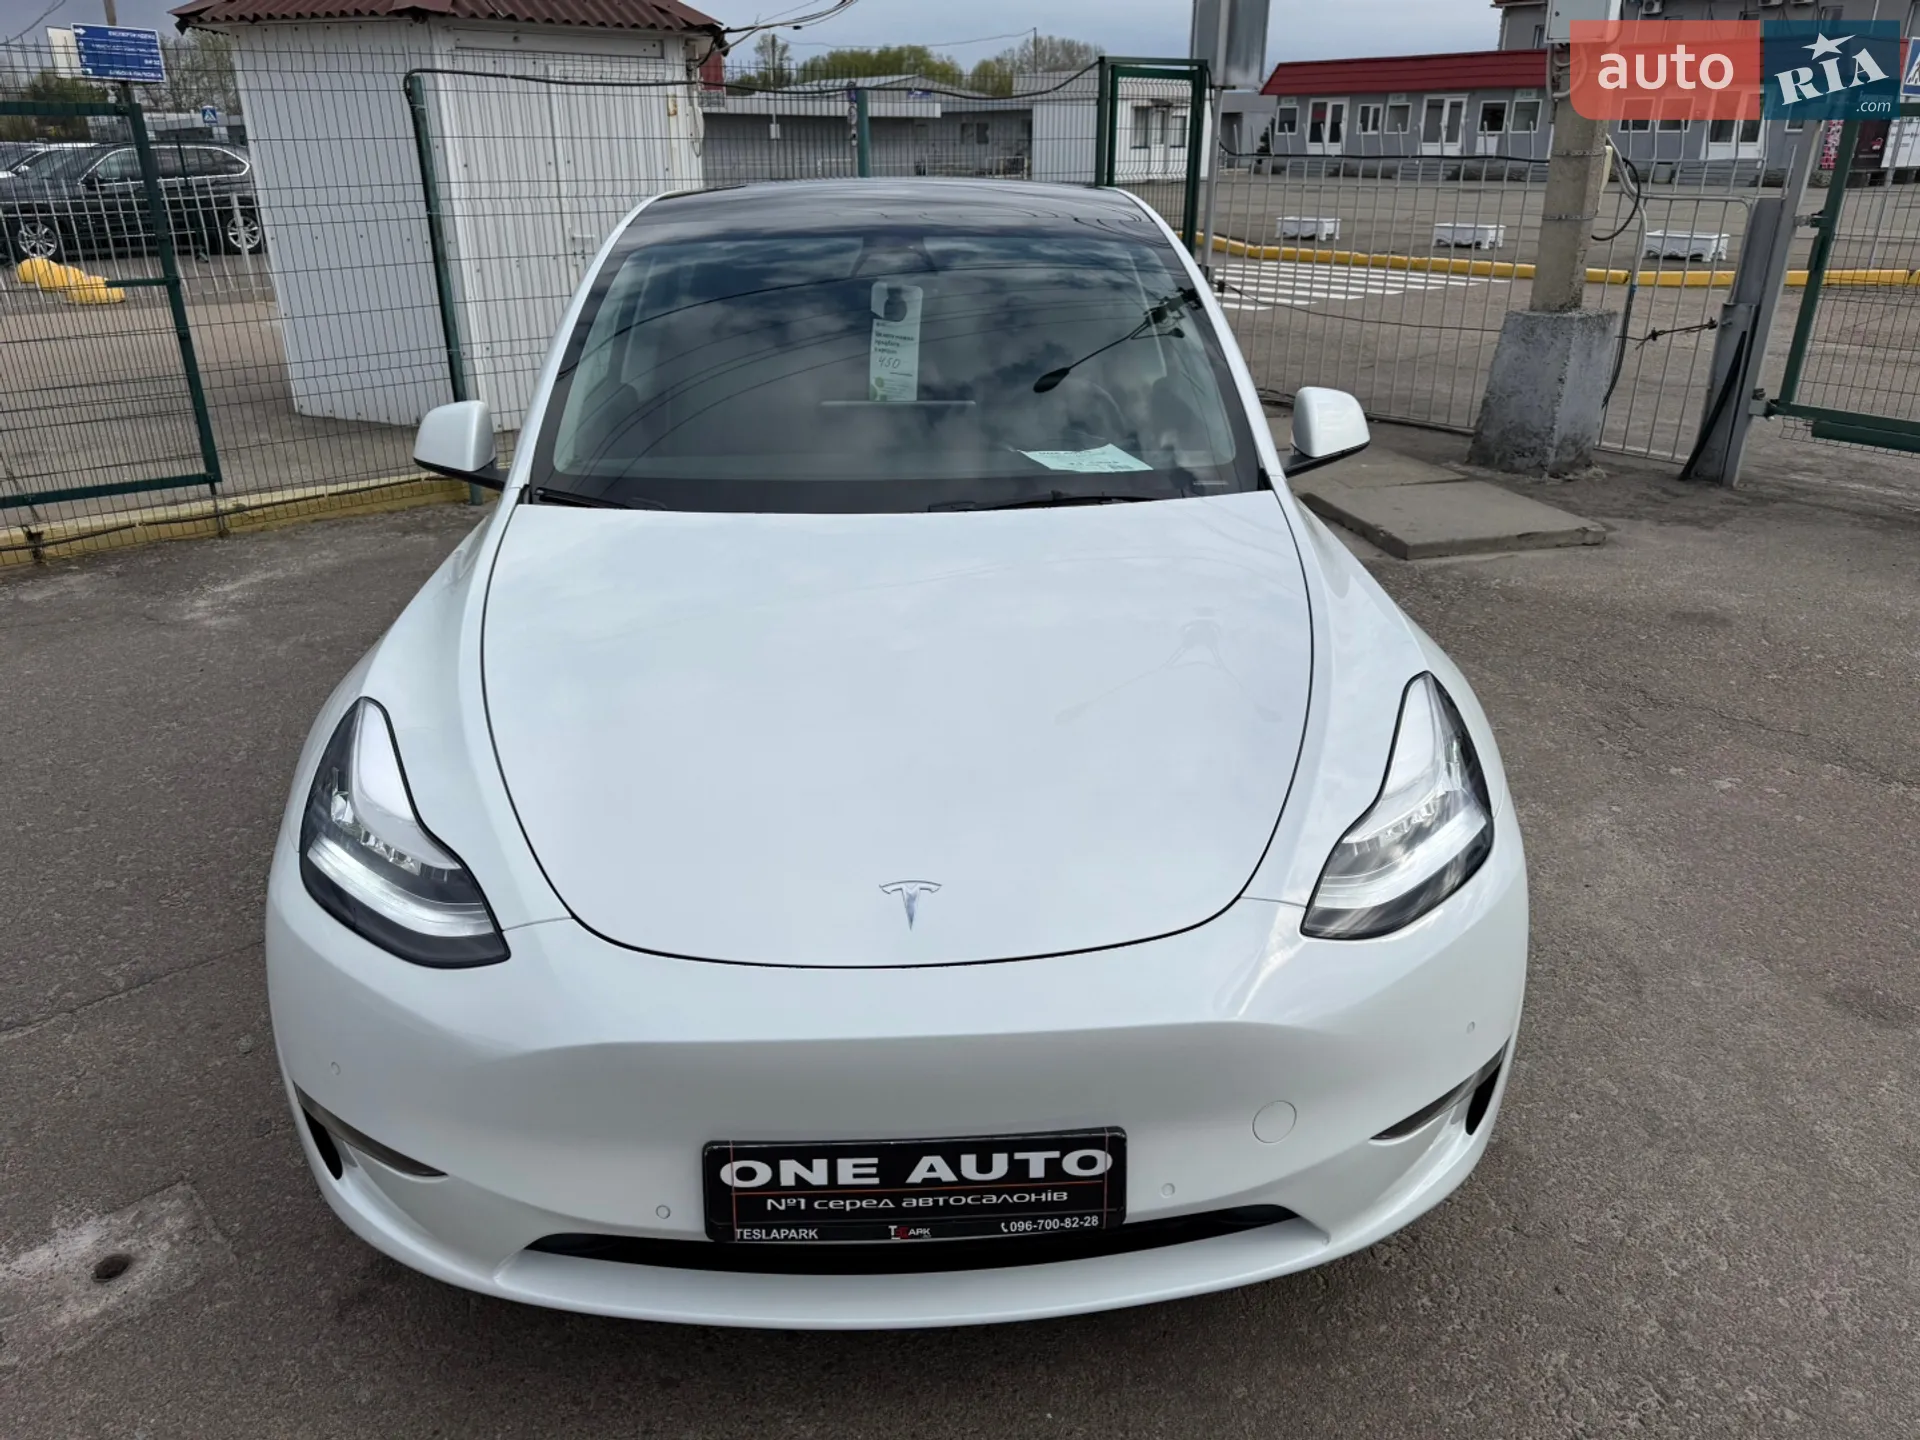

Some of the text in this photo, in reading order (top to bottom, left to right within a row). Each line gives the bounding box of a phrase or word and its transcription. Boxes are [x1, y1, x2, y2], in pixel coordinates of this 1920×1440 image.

[719, 1149, 1113, 1188] ONE AUTO
[813, 1197, 896, 1212] серед
[901, 1190, 1068, 1208] автосалонів
[1010, 1215, 1099, 1232] 096-700-82-28
[735, 1228, 819, 1240] TESLAPARK
